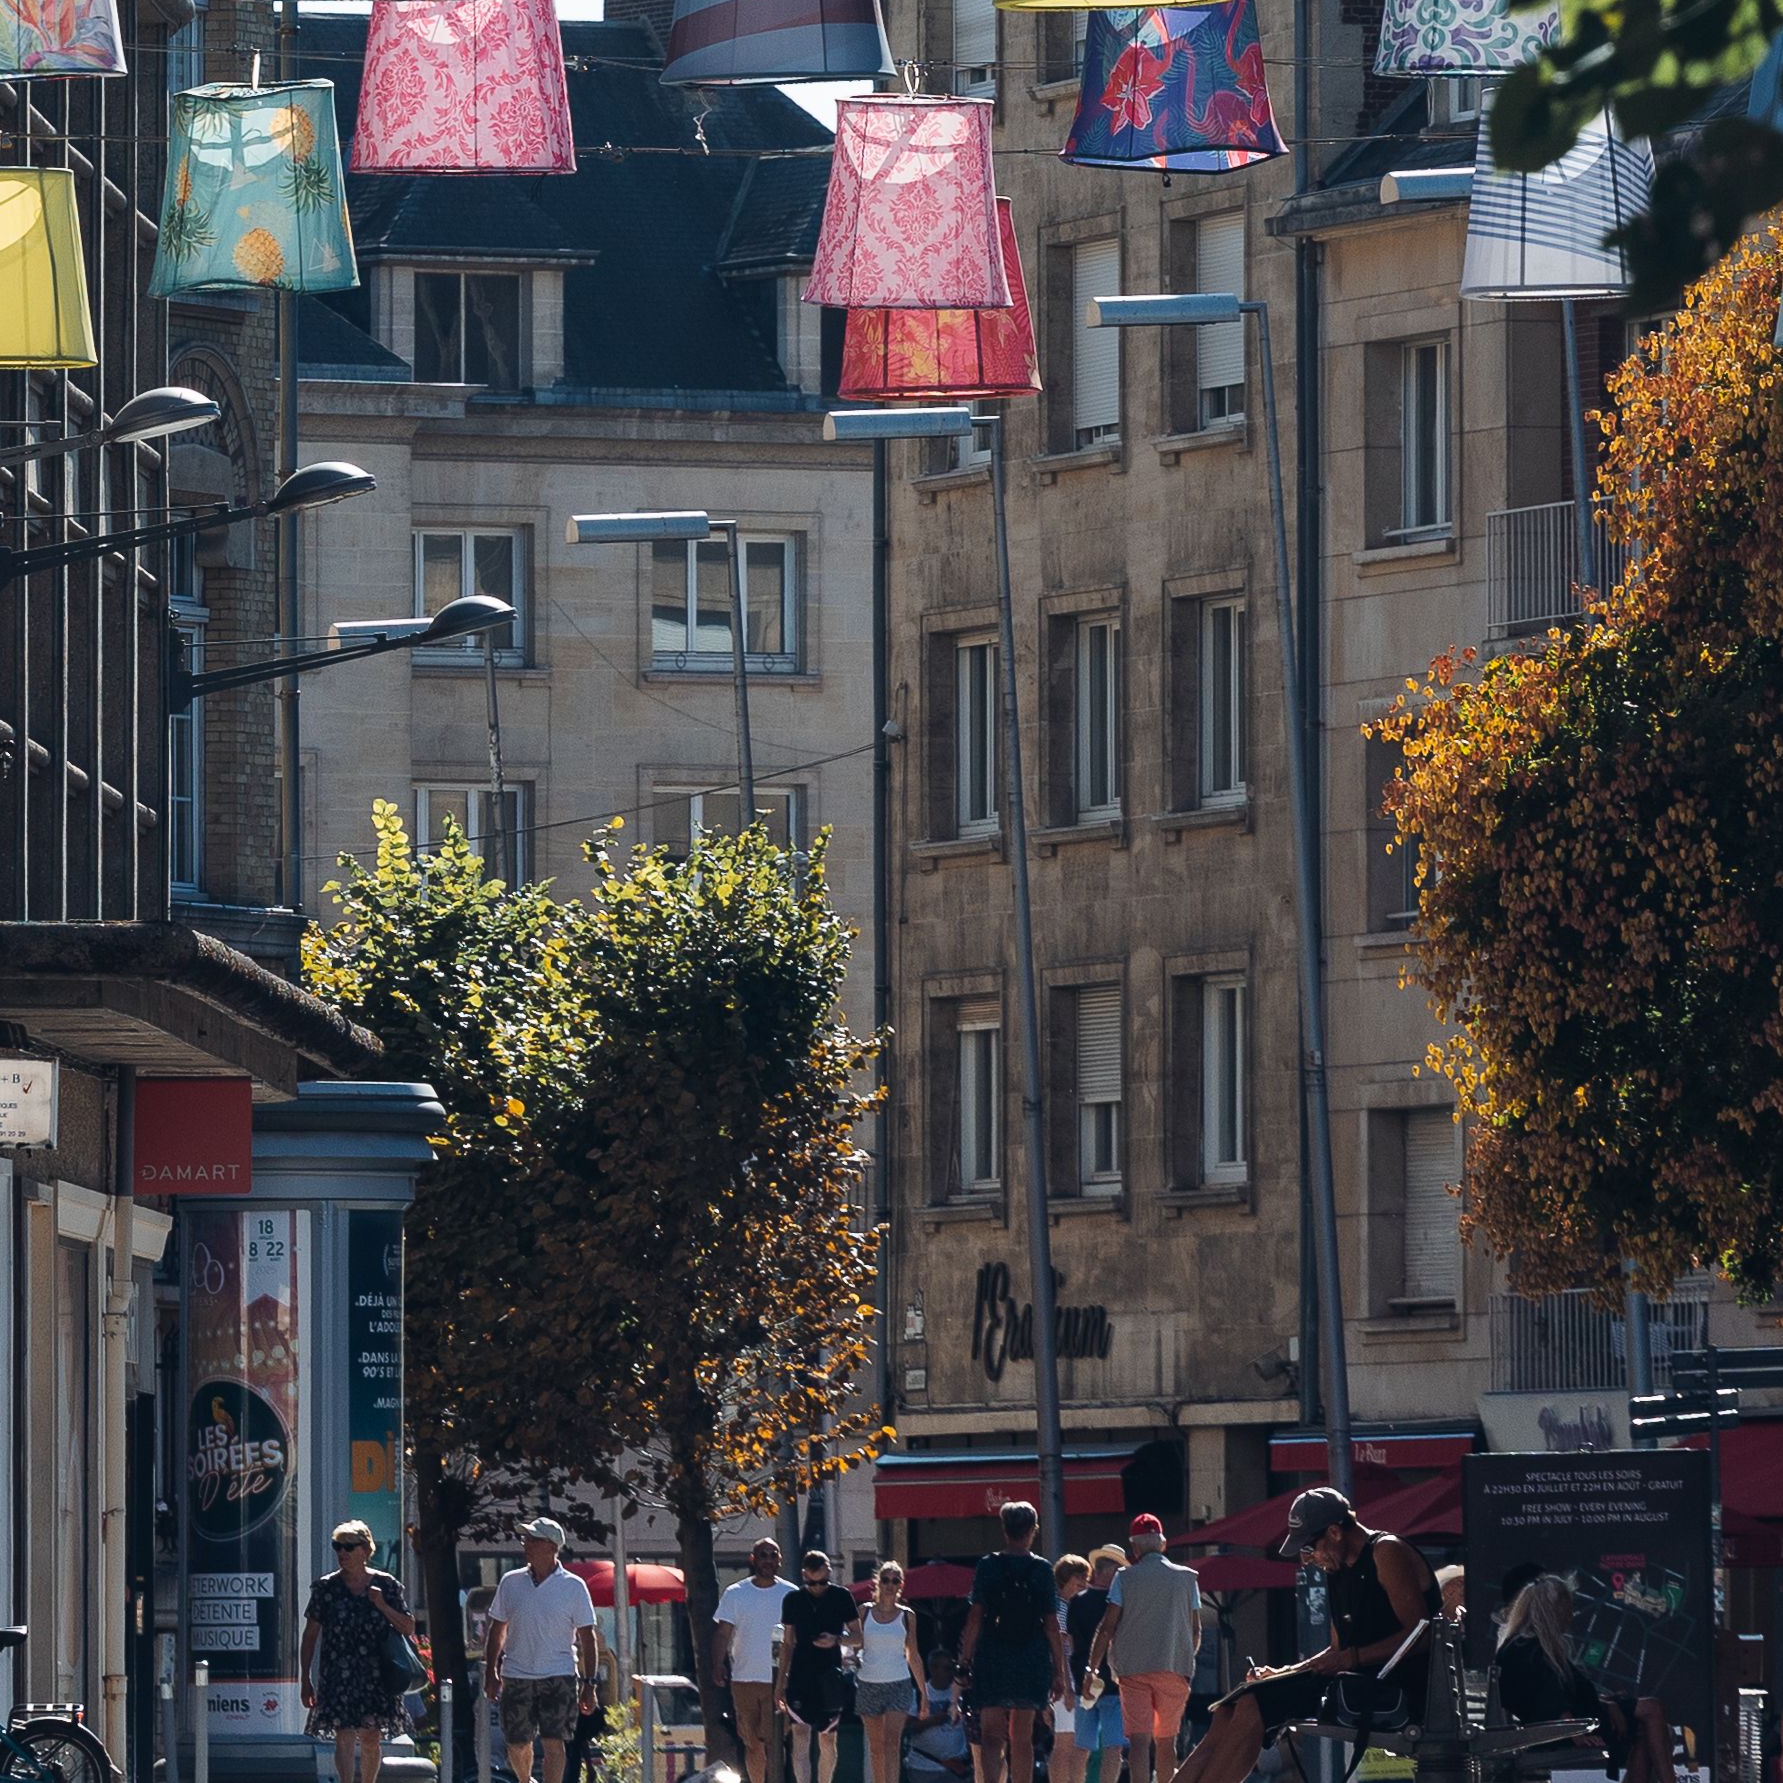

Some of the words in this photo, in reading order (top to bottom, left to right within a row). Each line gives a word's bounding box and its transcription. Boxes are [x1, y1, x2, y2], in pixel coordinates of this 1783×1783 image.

[139, 1164, 241, 1181] DAMART
[258, 1219, 274, 1235] 18
[248, 1241, 258, 1257] 8
[266, 1241, 285, 1257] 22
[198, 1423, 228, 1451] LES
[188, 1435, 284, 1481] SOIRÉES
[1525, 1471, 1572, 1482] SPECTACLE
[1574, 1471, 1596, 1481] TOUS
[1598, 1470, 1614, 1480] LES
[1615, 1469, 1642, 1480] SOIRS
[1537, 1483, 1568, 1493] JUILLET
[1647, 1479, 1683, 1490] GRATUIT
[1522, 1503, 1542, 1513] FREE
[1544, 1503, 1572, 1513] SHOW
[1579, 1502, 1606, 1512] EVERY
[1607, 1501, 1647, 1512] EVENING
[1634, 1511, 1669, 1523] AUGUST
